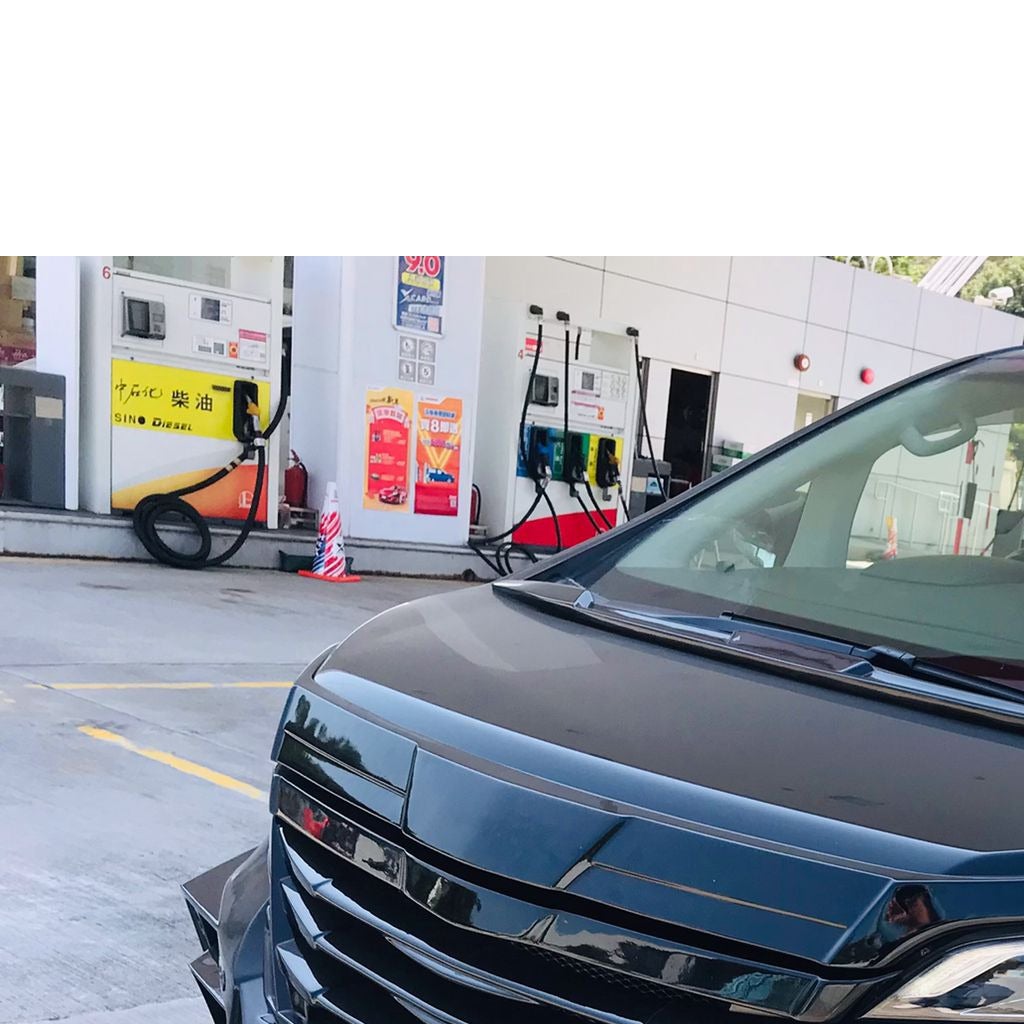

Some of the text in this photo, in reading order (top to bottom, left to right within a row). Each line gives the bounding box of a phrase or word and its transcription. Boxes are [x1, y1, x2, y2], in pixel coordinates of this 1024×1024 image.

[102, 265, 112, 280] 6
[114, 377, 213, 412] 中石化 柴油
[114, 412, 146, 425] SINO
